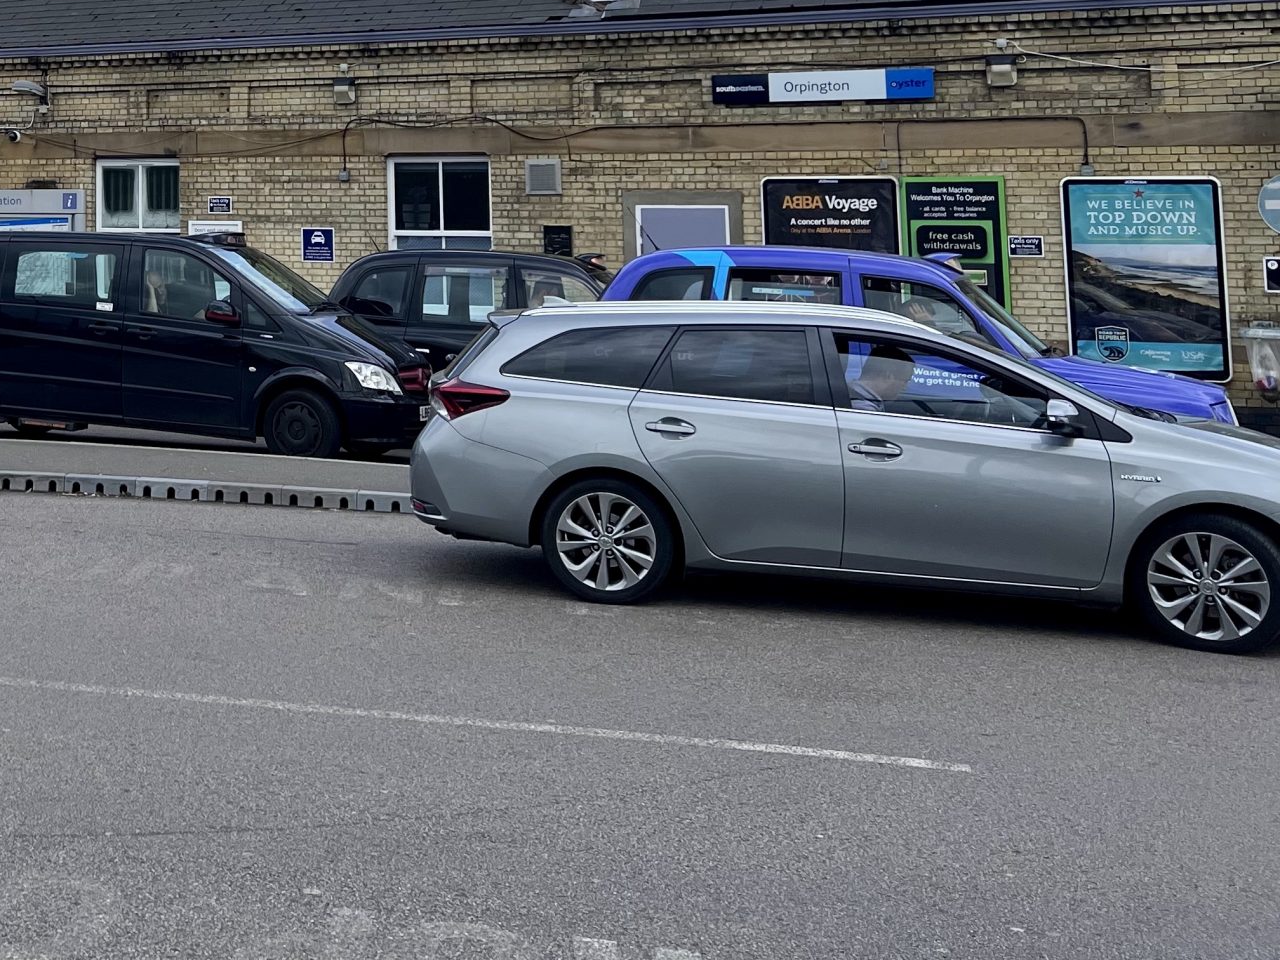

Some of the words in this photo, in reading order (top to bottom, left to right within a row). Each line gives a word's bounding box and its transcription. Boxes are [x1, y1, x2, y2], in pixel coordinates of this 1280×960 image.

[783, 81, 850, 95] Orpington
[890, 79, 928, 89] oyster
[782, 195, 823, 209] ABBA
[825, 195, 877, 212] Voyage
[1087, 200, 1108, 209] WE
[1115, 200, 1173, 209] BELIEVE
[1179, 200, 1195, 209] IN
[797, 218, 825, 226] concert
[1086, 212, 1125, 224] TOP
[1132, 212, 1196, 224] DOWN
[1088, 226, 1119, 235] AND
[1124, 226, 1172, 235] MUSIC
[1177, 225, 1201, 235] UP.
[923, 242, 981, 250] withdrawals
[913, 367, 940, 377] Want
[926, 378, 943, 386] got
[945, 378, 961, 386] the
